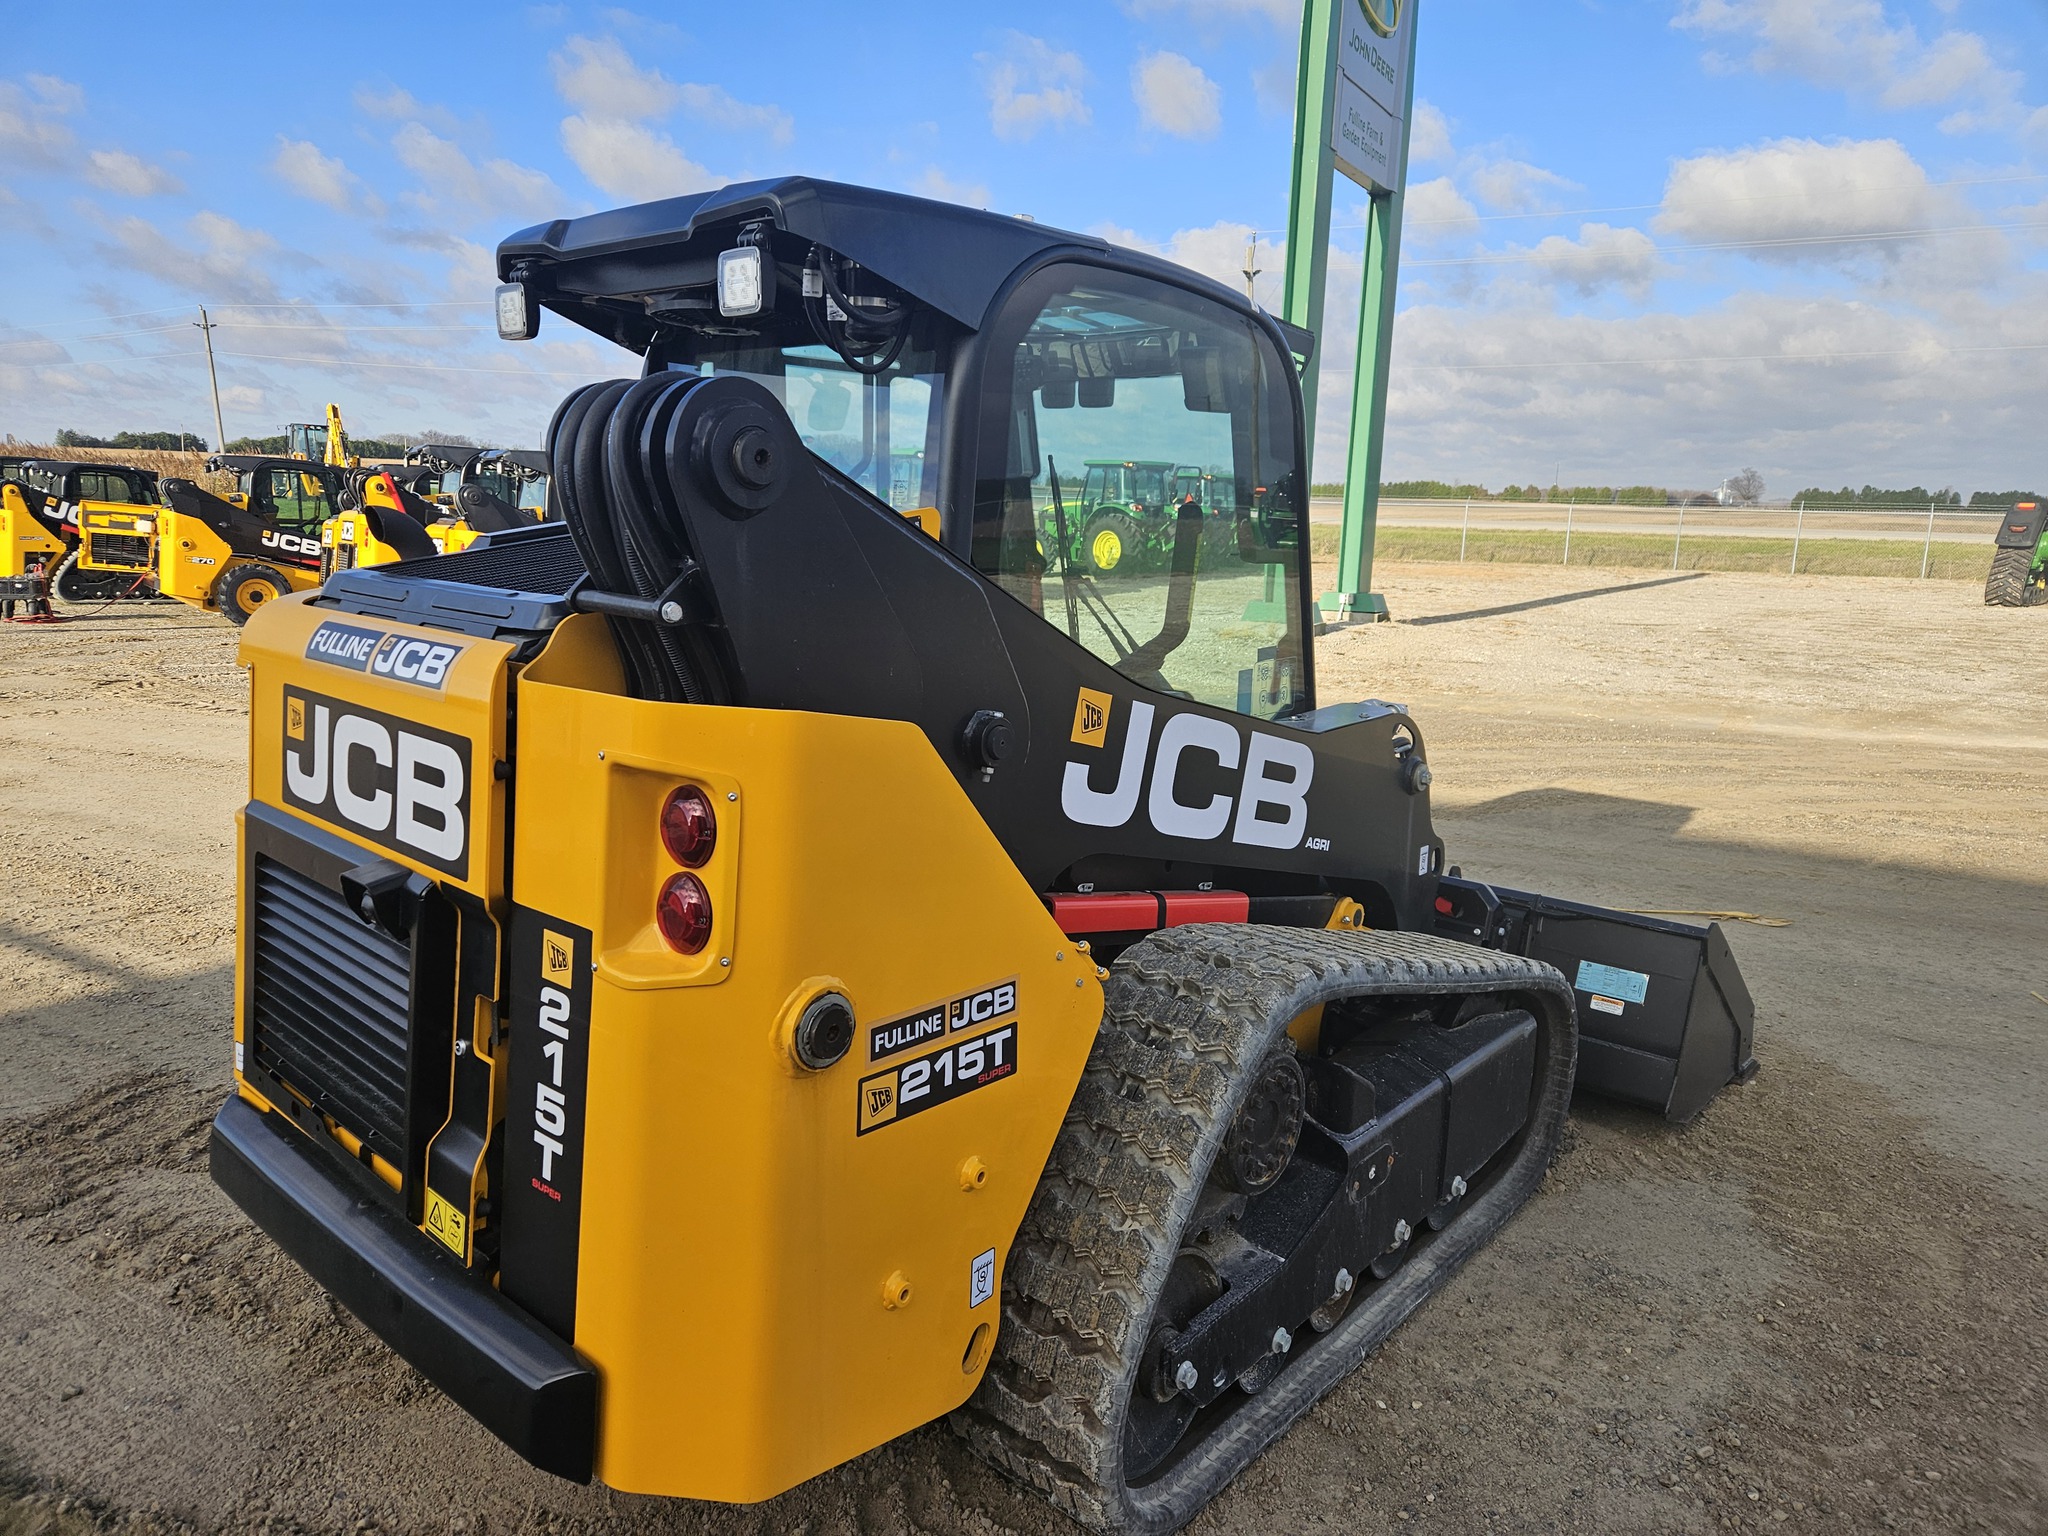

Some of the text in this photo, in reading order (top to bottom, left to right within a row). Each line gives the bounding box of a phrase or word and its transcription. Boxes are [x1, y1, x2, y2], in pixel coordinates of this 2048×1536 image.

[1348, 28, 1395, 85] JOHN DEERE
[1348, 106, 1384, 145] Fulline Farm &
[1342, 124, 1387, 168] Garden Equipment
[261, 532, 322, 556] JCB
[311, 628, 376, 662] FULLINE
[373, 638, 456, 684] JCB
[1083, 704, 1103, 729] JCB
[286, 704, 465, 861] JCB
[1061, 699, 1315, 850] JCB
[1304, 836, 1331, 852] AGRI
[550, 944, 568, 970] JCB
[951, 984, 1015, 1029] JCB
[874, 1013, 942, 1053] FULLINE
[533, 985, 571, 1182] 215T
[900, 1028, 1012, 1104] 215T
[977, 1063, 1012, 1084] SUPER
[870, 1088, 892, 1114] JCB
[531, 1176, 562, 1202] SUPER
